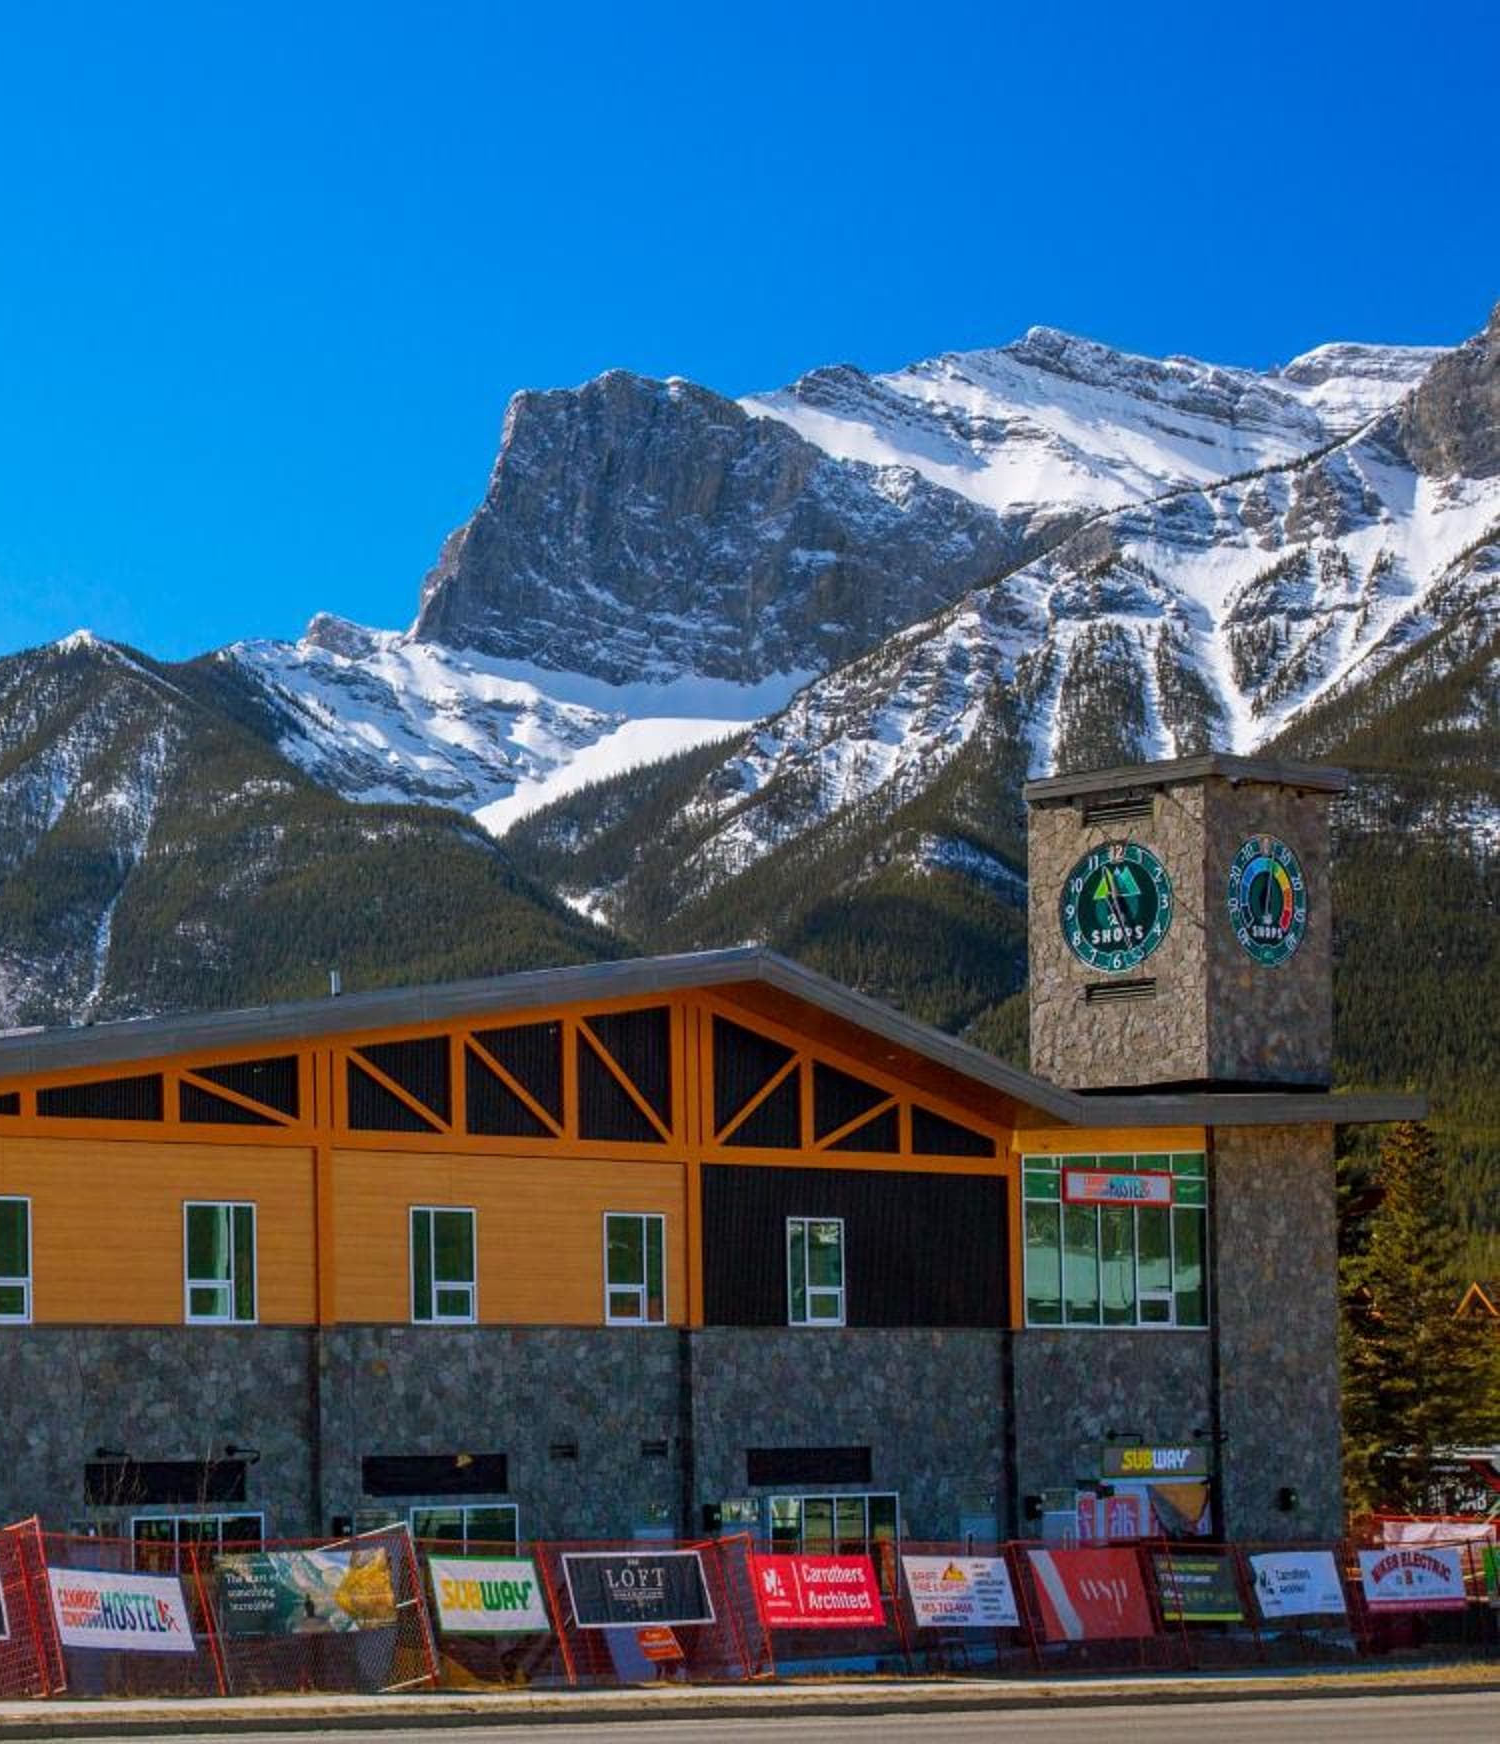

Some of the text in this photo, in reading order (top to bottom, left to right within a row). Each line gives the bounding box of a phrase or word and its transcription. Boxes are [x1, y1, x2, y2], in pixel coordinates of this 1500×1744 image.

[1089, 855, 1099, 870] 11
[1070, 877, 1083, 893] 10
[1160, 893, 1168, 909] 3
[1065, 904, 1075, 921] 9
[1091, 924, 1144, 945] SHOPS
[1153, 921, 1163, 937] 4
[1072, 930, 1081, 947] 8
[1112, 952, 1121, 969] 6
[1121, 1447, 1190, 1470] SUBWAY
[604, 1567, 665, 1588] LOFT
[440, 1578, 533, 1611] SUBWAY
[808, 1590, 871, 1609] Architect
[101, 1591, 167, 1632] HOSTEL
